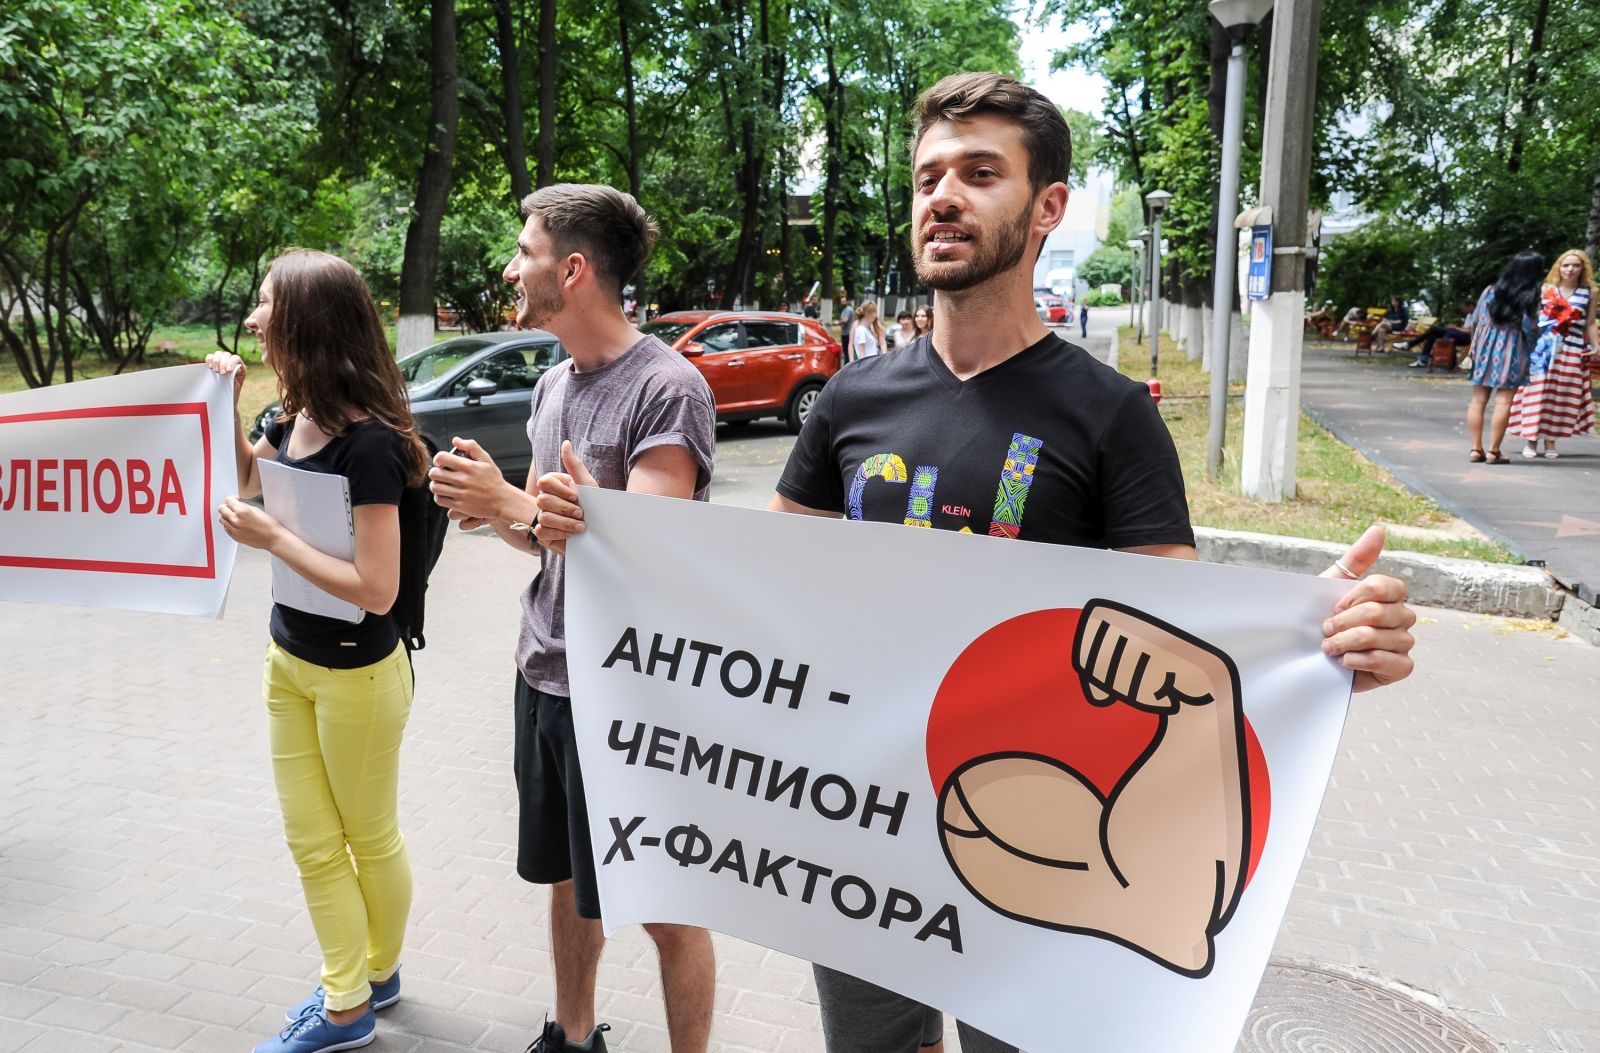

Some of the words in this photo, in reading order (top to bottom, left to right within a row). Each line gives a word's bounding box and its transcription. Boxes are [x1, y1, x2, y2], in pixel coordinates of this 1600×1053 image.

[0, 459, 187, 516] ЛЕПОВА
[601, 627, 810, 710] АНТОН
[607, 719, 910, 837] ЧЕМПИОН
[602, 816, 964, 955] Х-ФАКТОРА
